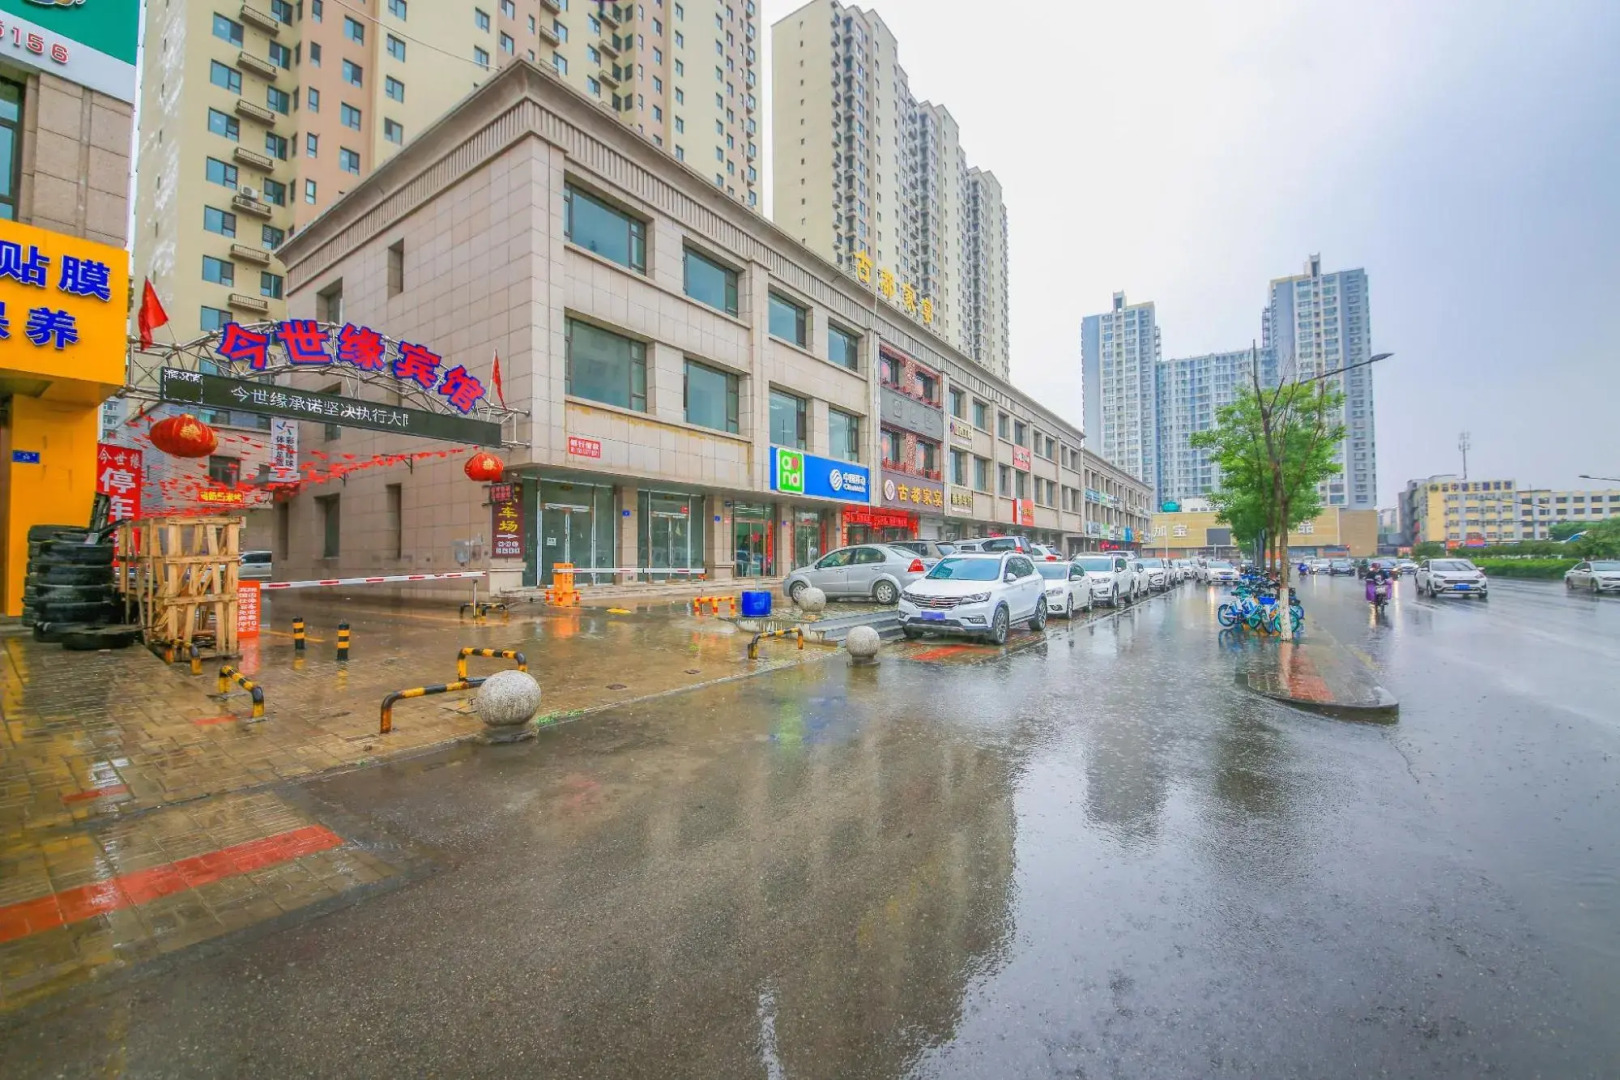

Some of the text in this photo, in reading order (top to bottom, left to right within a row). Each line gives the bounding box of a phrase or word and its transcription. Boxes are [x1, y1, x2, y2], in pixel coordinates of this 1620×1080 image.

[0, 21, 69, 64] 156
[0, 239, 111, 302] 贴膜
[0, 302, 79, 350] 养
[217, 320, 487, 415] 今世缘宾馆
[498, 493, 518, 533] 车场
